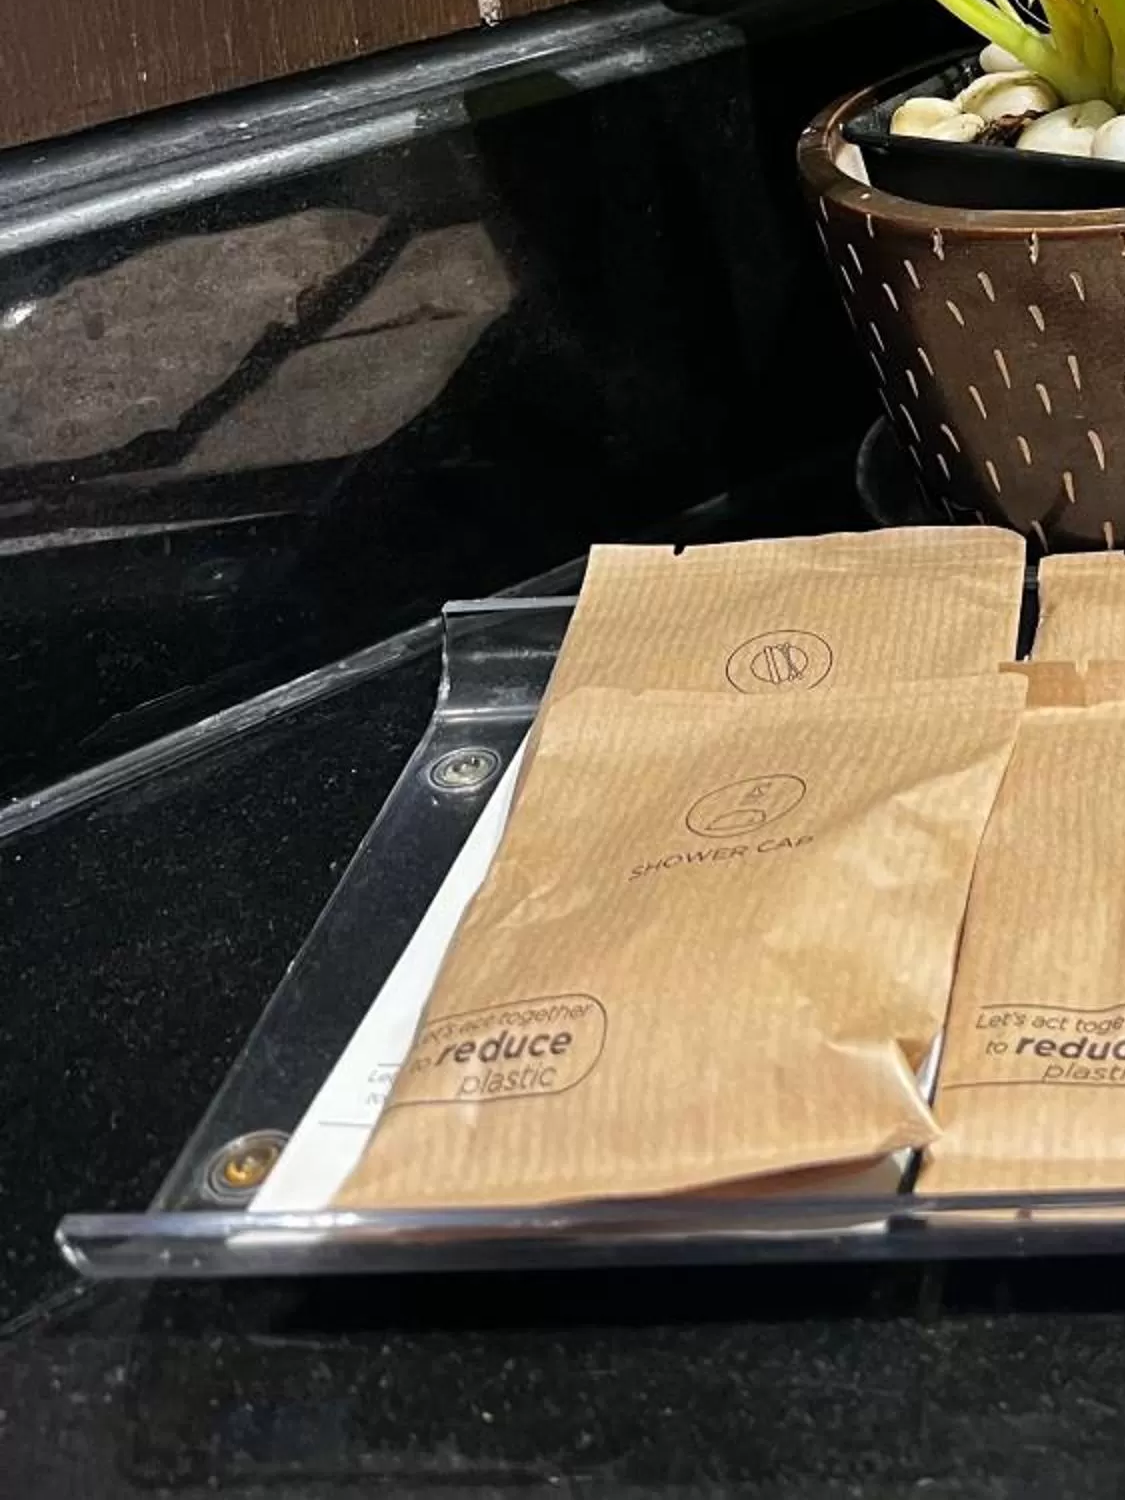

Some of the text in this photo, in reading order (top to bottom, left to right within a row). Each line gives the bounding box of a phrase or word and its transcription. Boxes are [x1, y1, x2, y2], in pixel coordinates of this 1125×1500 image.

[627, 835, 815, 882] SHOWER CAP
[500, 1003, 596, 1027] together
[975, 1011, 1025, 1031] Let's
[1031, 1013, 1069, 1033] act
[435, 1029, 573, 1067] reduce
[985, 1039, 1008, 1055] to
[455, 1061, 558, 1099] plastic
